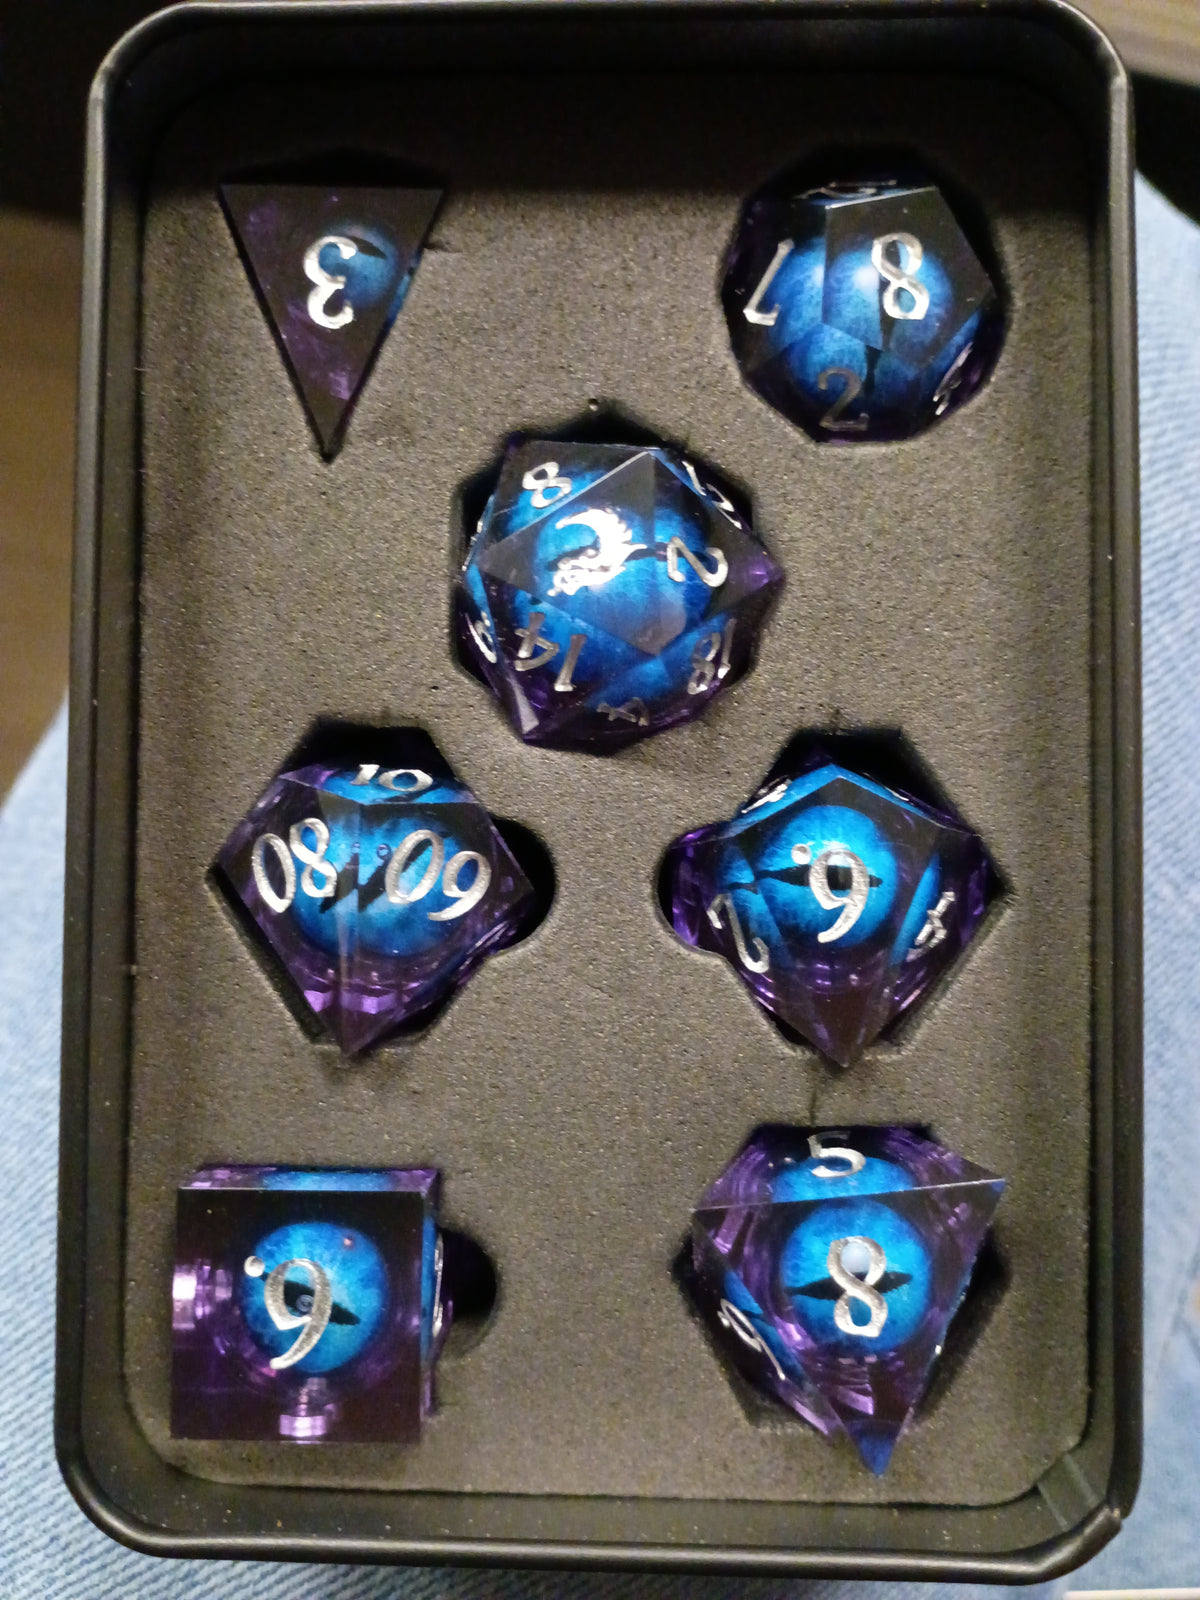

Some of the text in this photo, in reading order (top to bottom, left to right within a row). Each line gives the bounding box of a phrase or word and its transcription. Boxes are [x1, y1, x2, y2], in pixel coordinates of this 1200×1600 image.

[871, 232, 924, 321] 8
[817, 366, 870, 431] 2
[522, 461, 573, 509] 8
[666, 536, 729, 588] 2
[826, 1235, 889, 1338] 8
